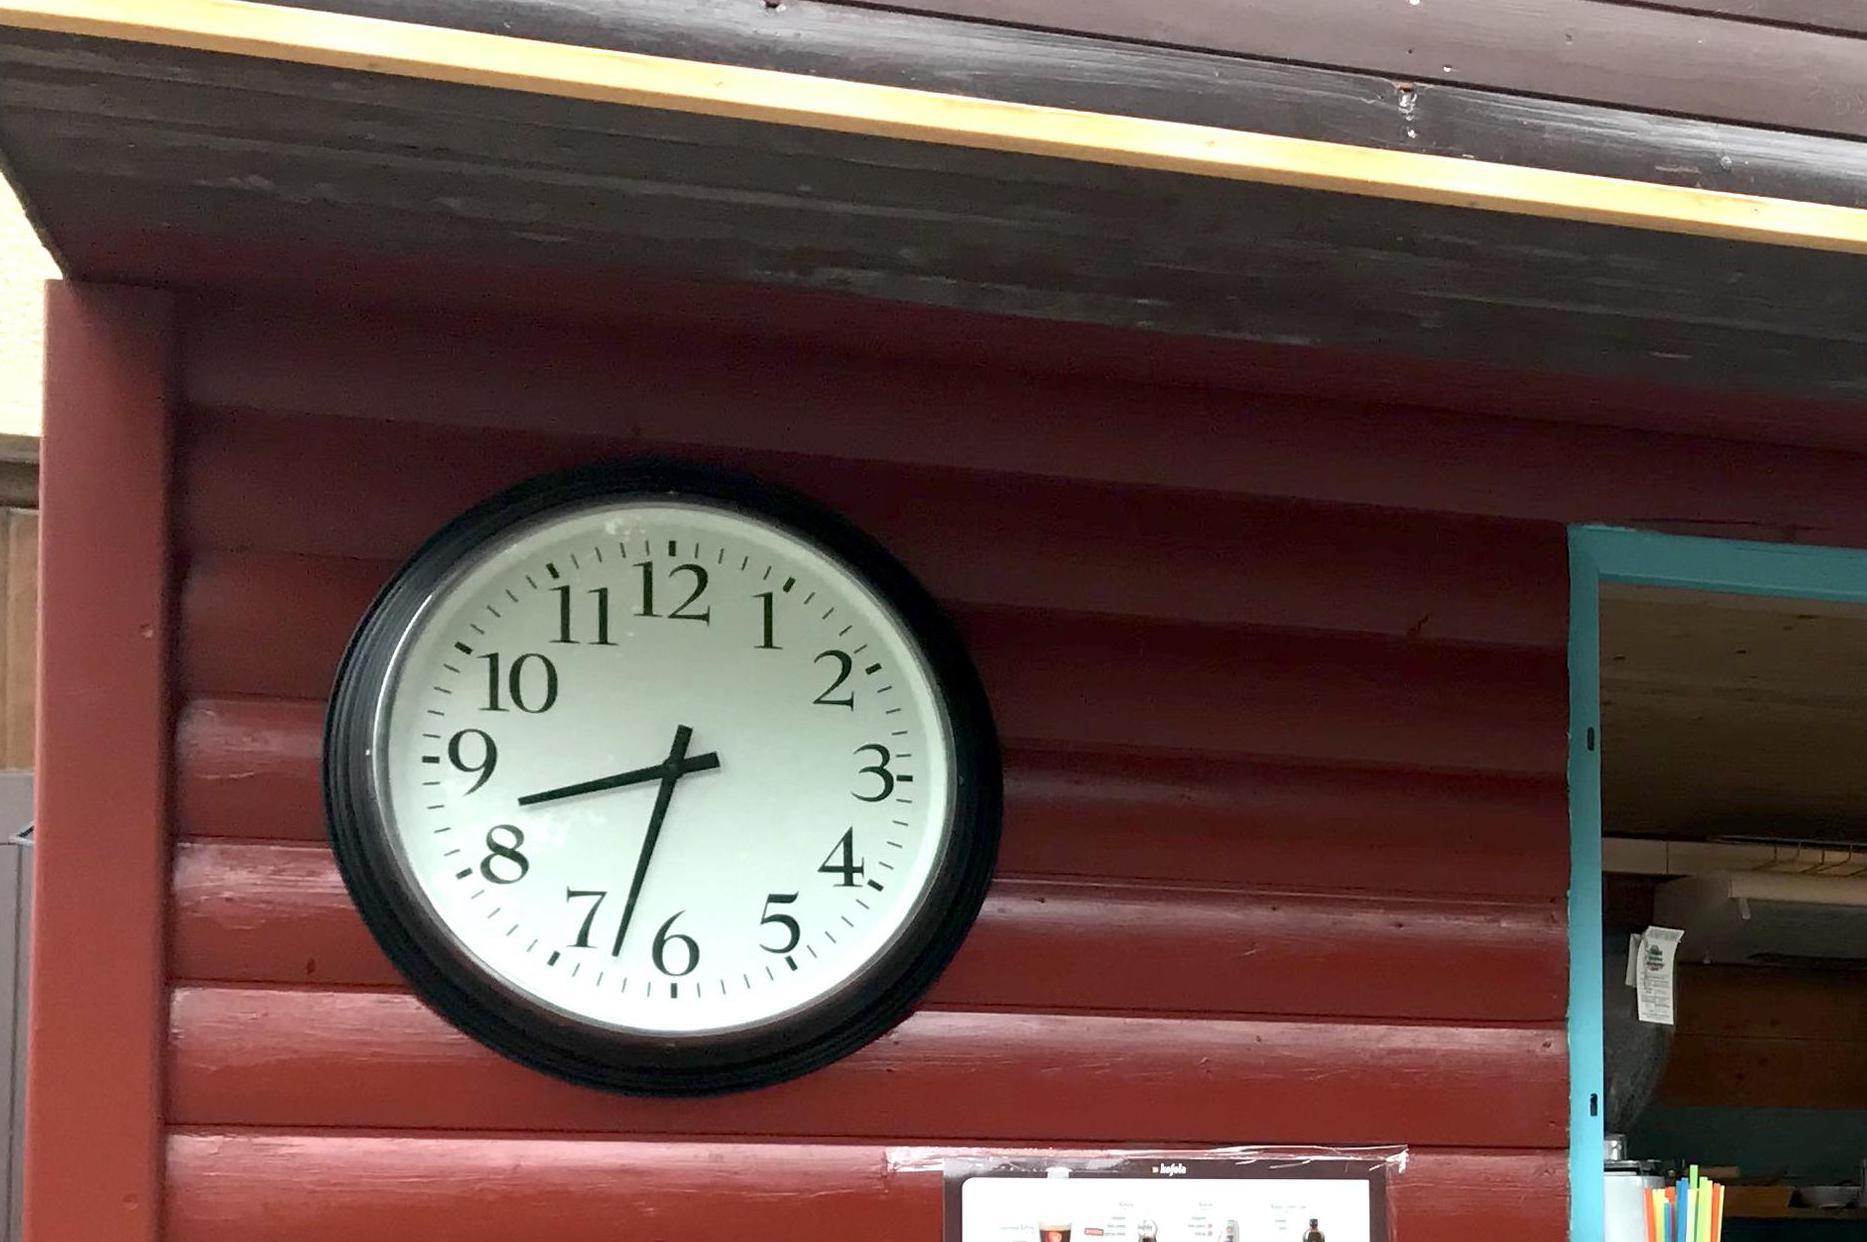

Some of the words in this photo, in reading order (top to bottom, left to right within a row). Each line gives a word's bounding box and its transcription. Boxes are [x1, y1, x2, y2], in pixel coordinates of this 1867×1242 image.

[549, 585, 620, 646] 11
[632, 560, 711, 626] 12
[753, 591, 784, 649] 1
[477, 652, 559, 715] 10
[812, 649, 855, 709] 2
[447, 728, 498, 797] 9
[849, 743, 895, 803] 3
[480, 824, 530, 884] 8
[816, 826, 865, 889] 4
[566, 886, 608, 949] 7
[651, 909, 701, 977] 6
[758, 891, 801, 955] 5
[1160, 1163, 1187, 1177] kofola
